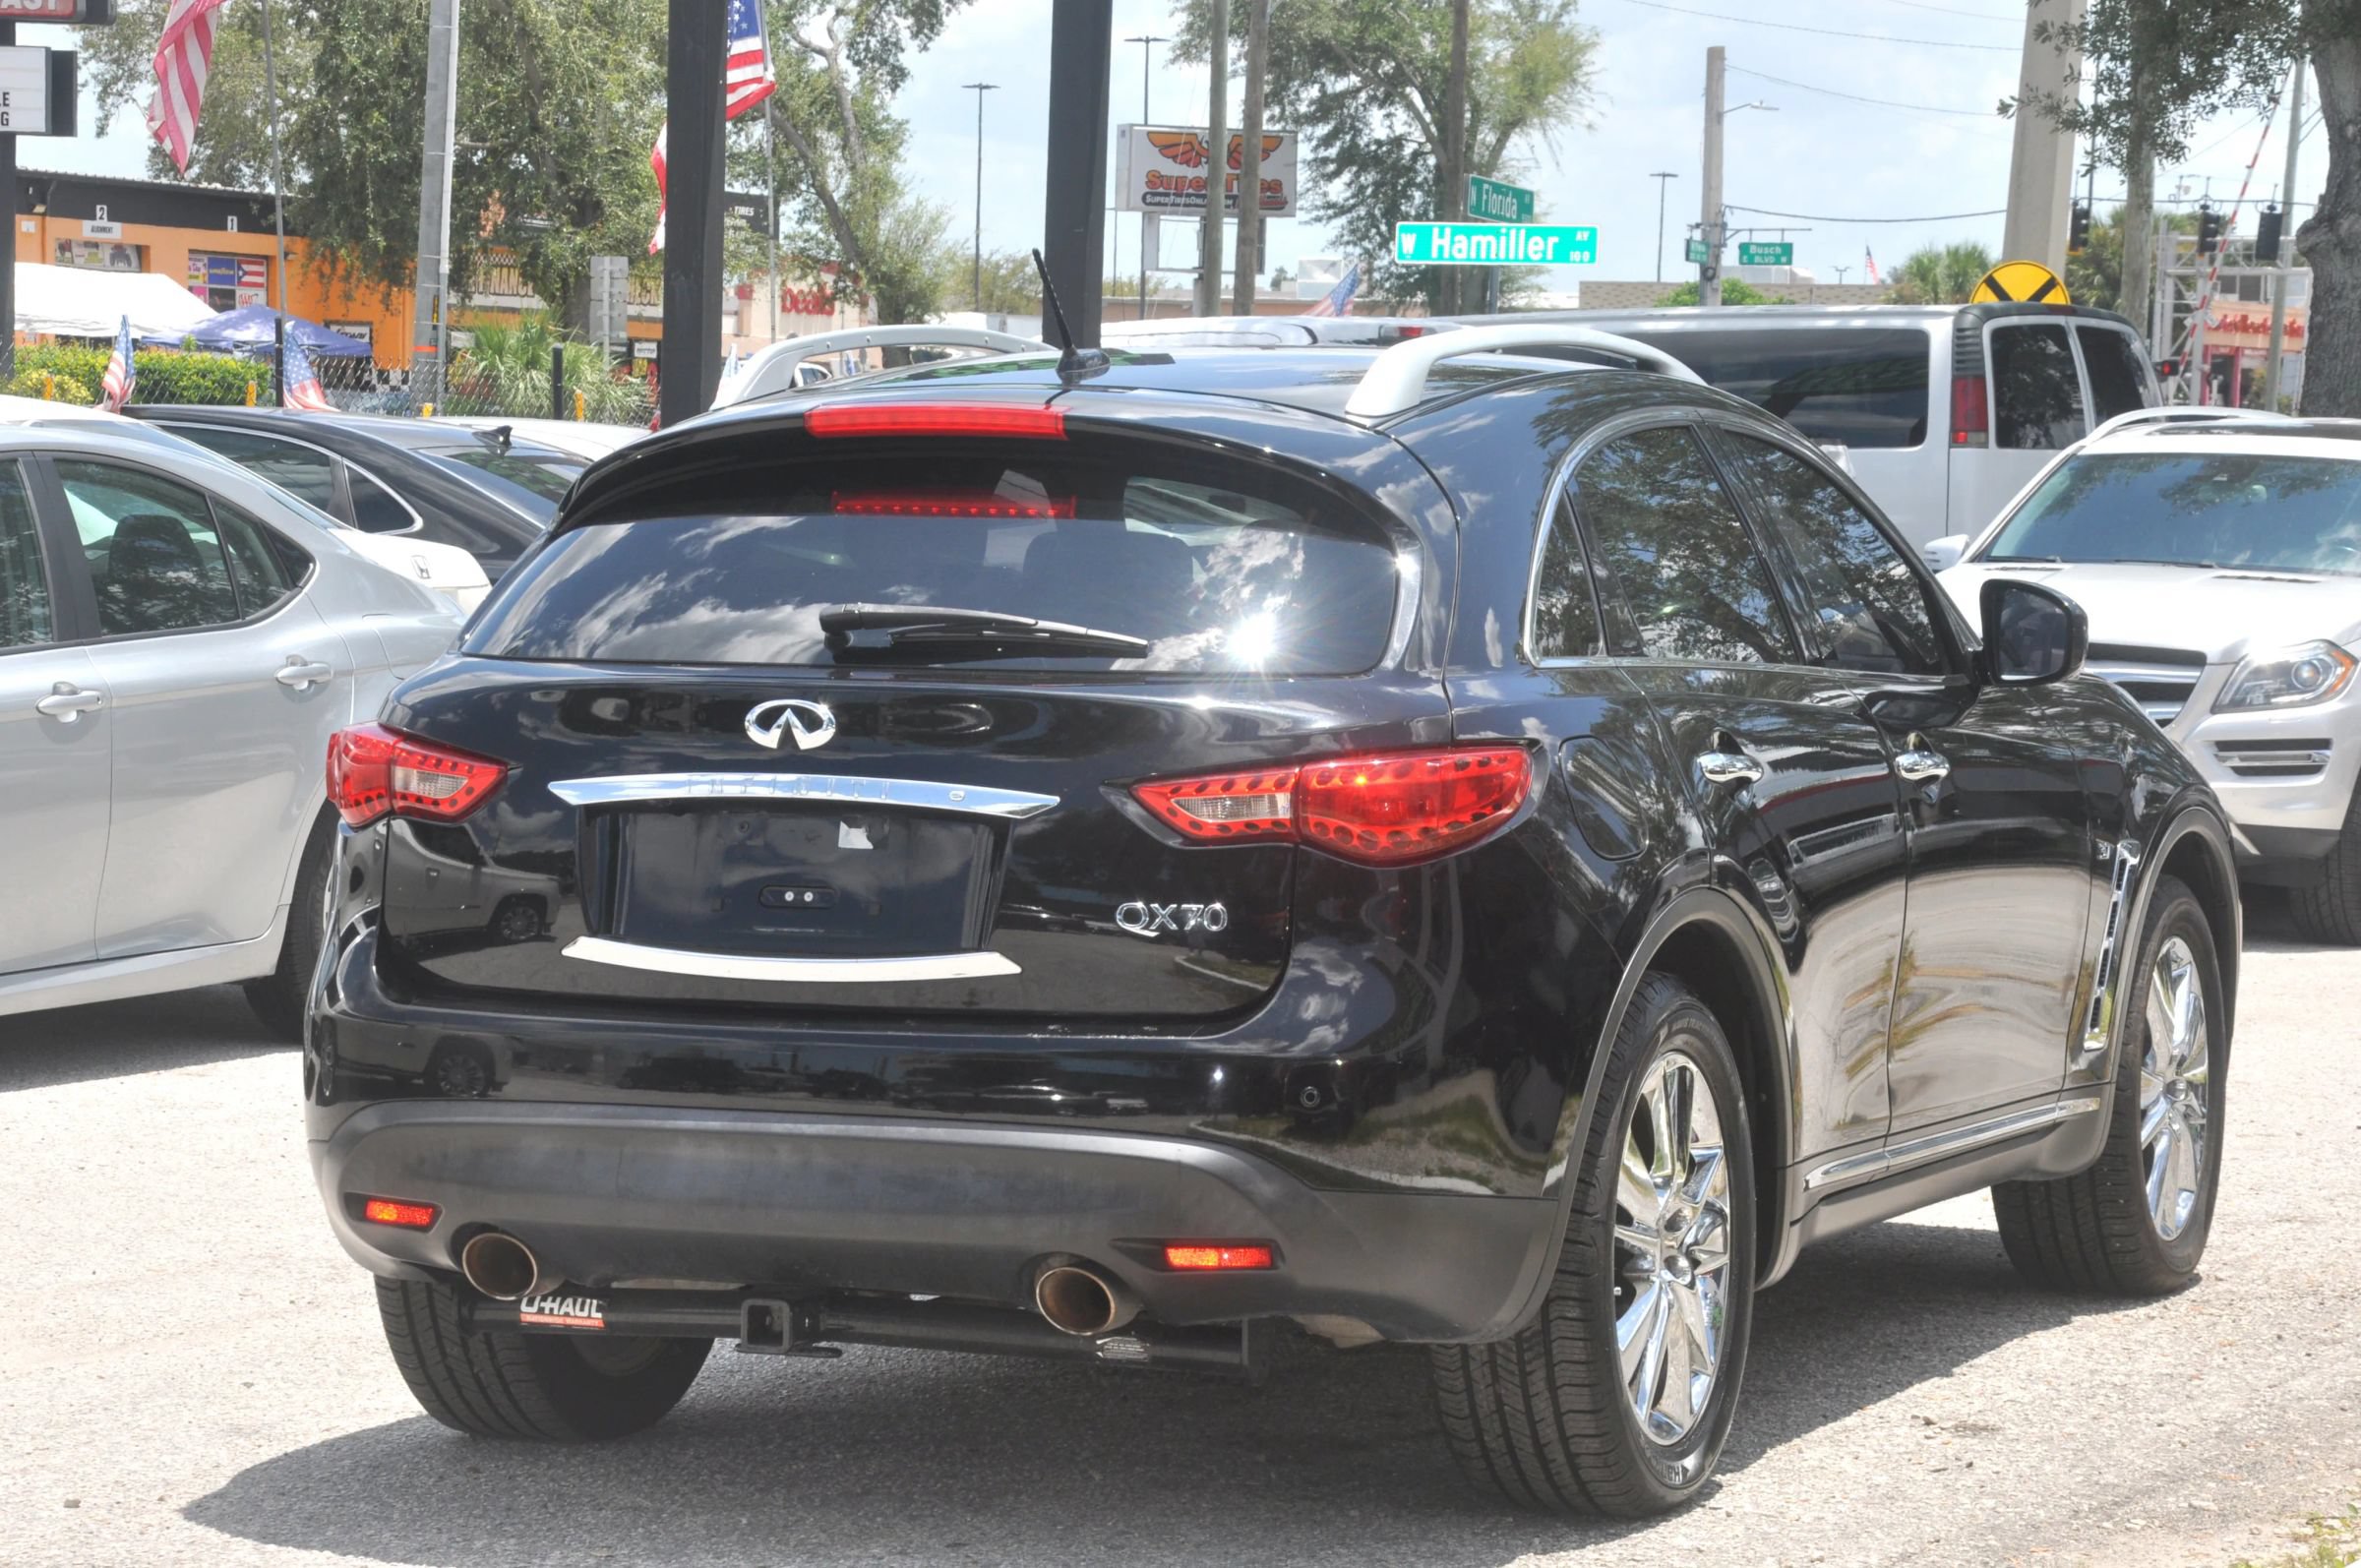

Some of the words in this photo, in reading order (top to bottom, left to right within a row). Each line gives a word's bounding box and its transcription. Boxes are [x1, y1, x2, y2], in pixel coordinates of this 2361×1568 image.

[1145, 169, 1209, 193] Supe
[1471, 185, 1477, 207] N
[1483, 183, 1518, 219] Florida
[98, 207, 105, 220] 2
[734, 206, 755, 216] TIRES
[230, 217, 235, 230] 1
[1401, 233, 1417, 255] W
[1431, 227, 1559, 260] Hamiller
[1750, 245, 1782, 255] Busch
[1569, 251, 1590, 262] 100
[1116, 902, 1228, 936] QX70
[520, 1296, 602, 1318] U-HAUL
